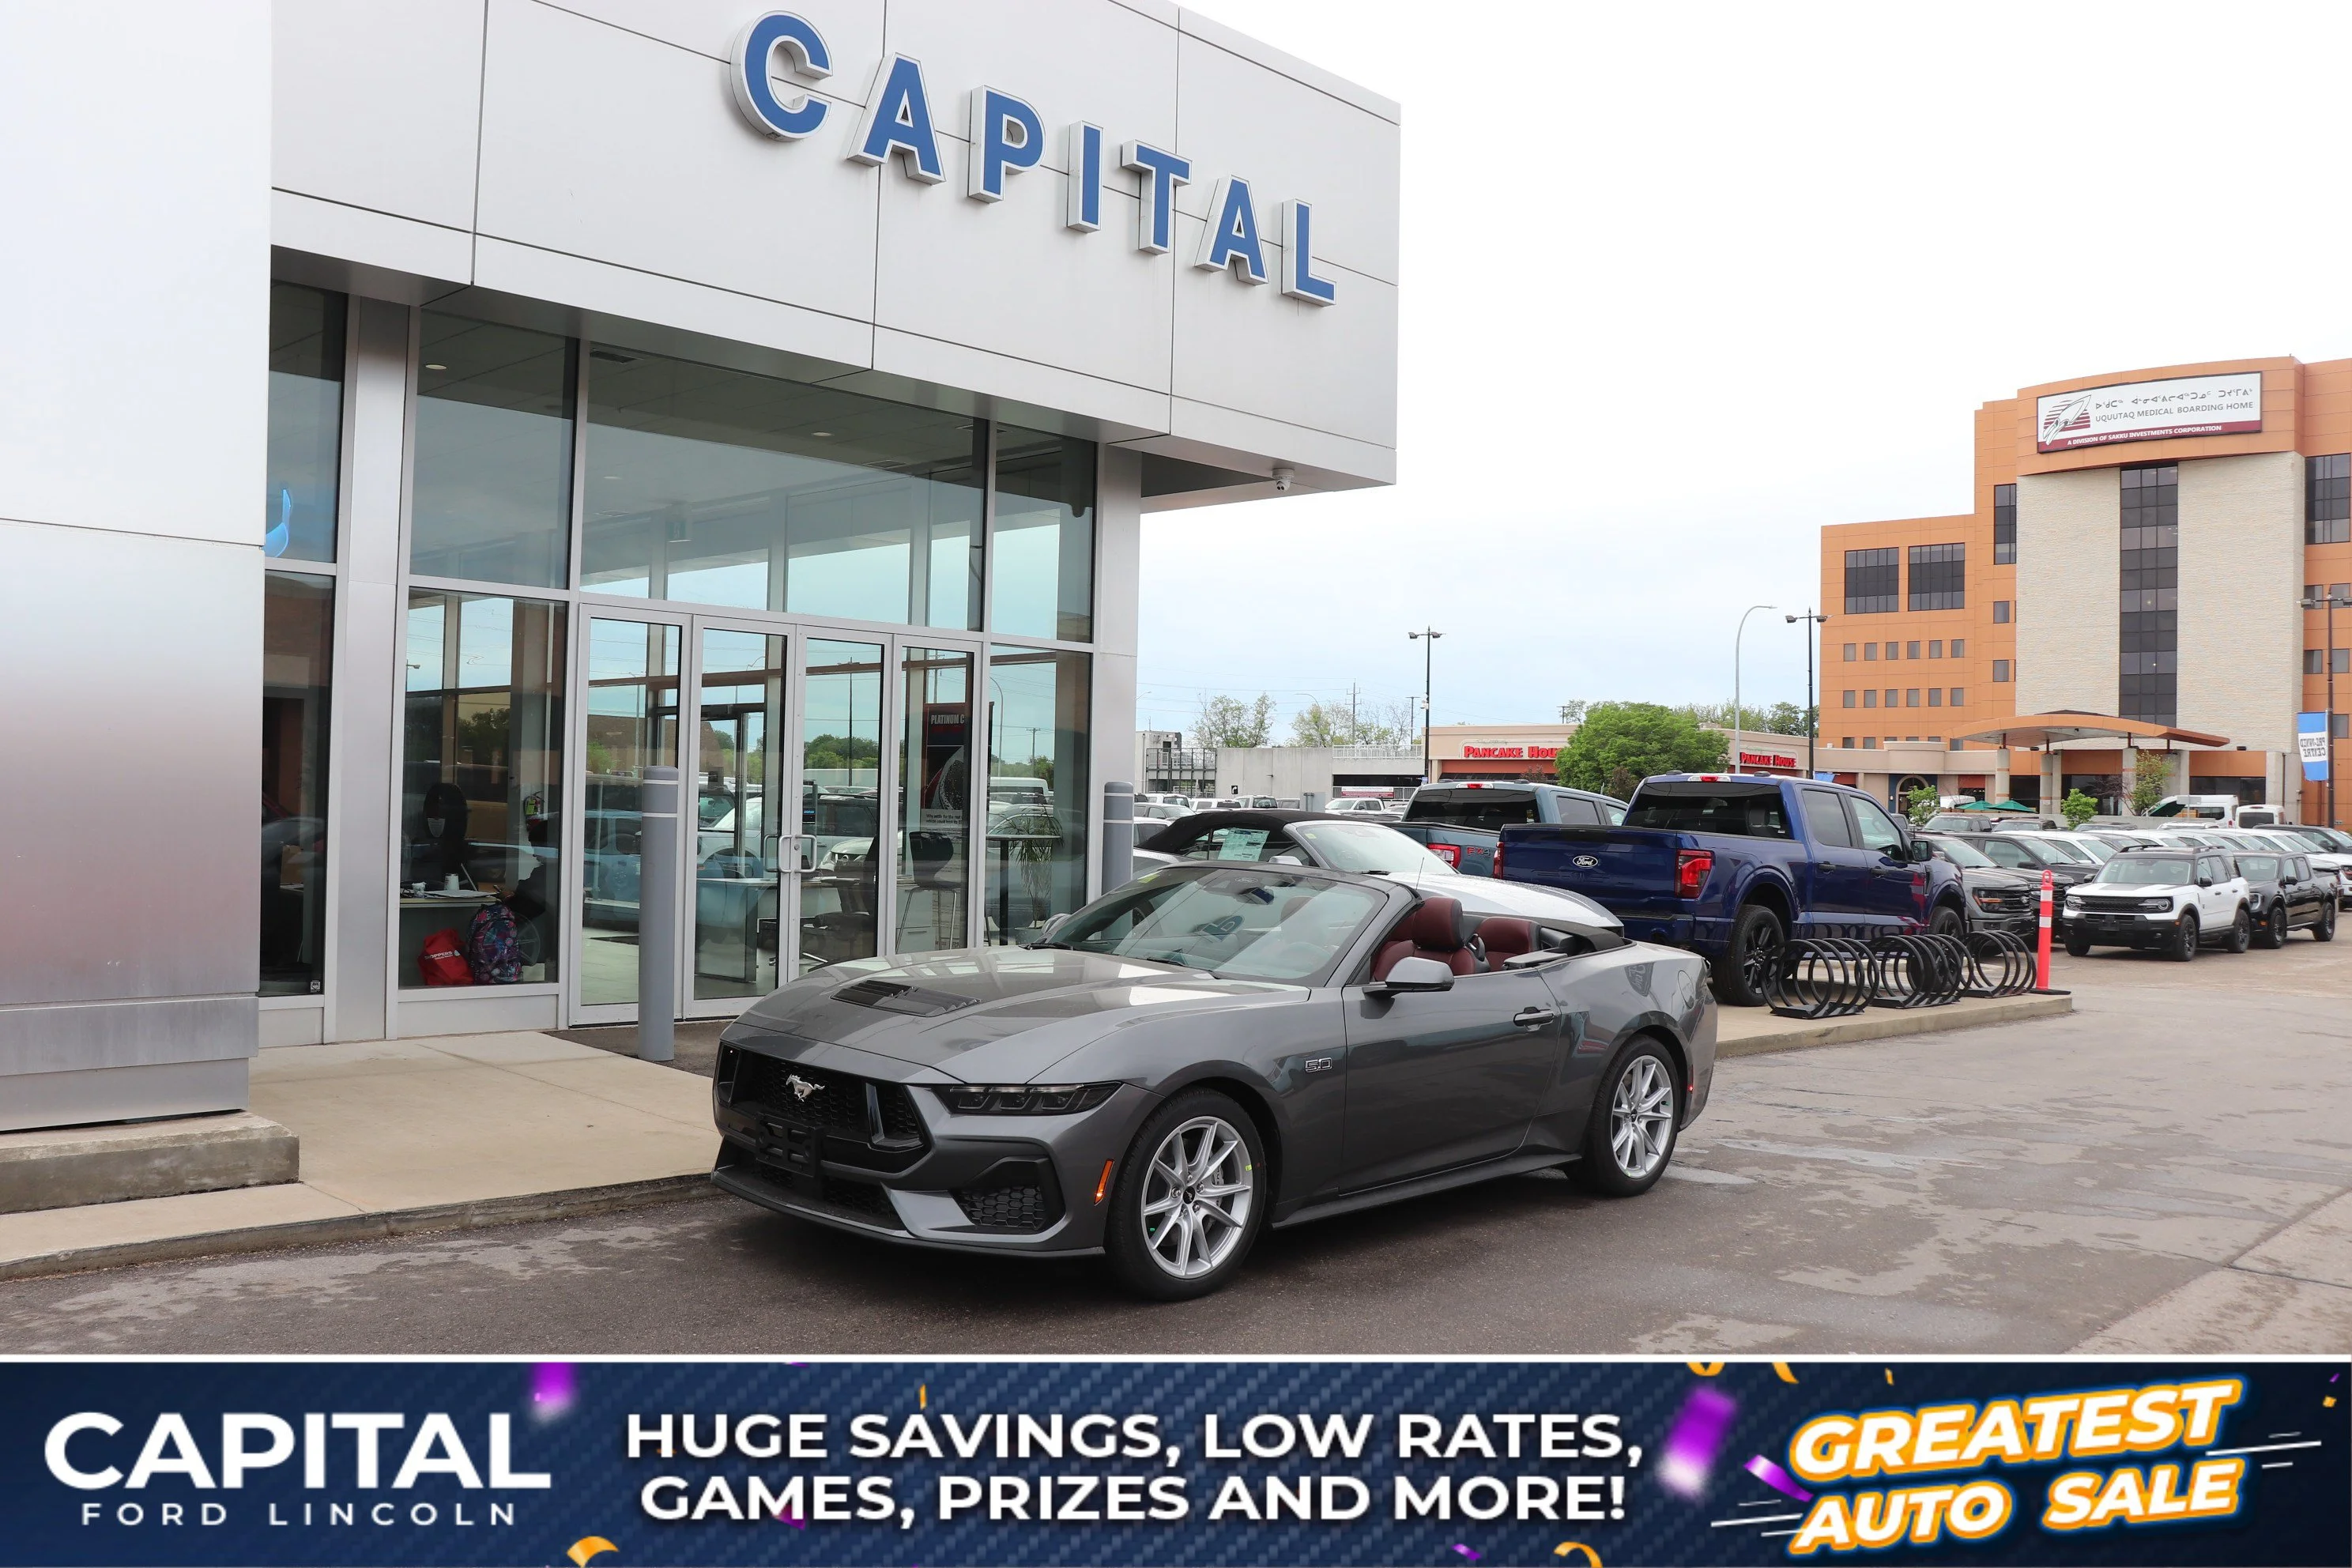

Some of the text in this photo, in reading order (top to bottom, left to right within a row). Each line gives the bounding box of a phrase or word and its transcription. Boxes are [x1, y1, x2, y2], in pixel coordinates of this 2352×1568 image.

[730, 10, 1337, 307] CAPITAL
[2096, 401, 2253, 422] UQUUTAQ MEDICAL BOARDING HOME
[2073, 436, 2098, 445] DIVISION
[2129, 428, 2173, 438] INVESTMENTS
[2173, 425, 2222, 434] CORPORATION
[931, 714, 959, 724] PLATINUM
[1464, 745, 1564, 759] PANCAKE HOU
[1740, 752, 1796, 767] PANCAKE HOUSE
[1467, 846, 1491, 857] FX4
[1575, 856, 1596, 866] Ford
[424, 951, 453, 959] OPPERS
[1305, 1057, 1332, 1073] 5.0
